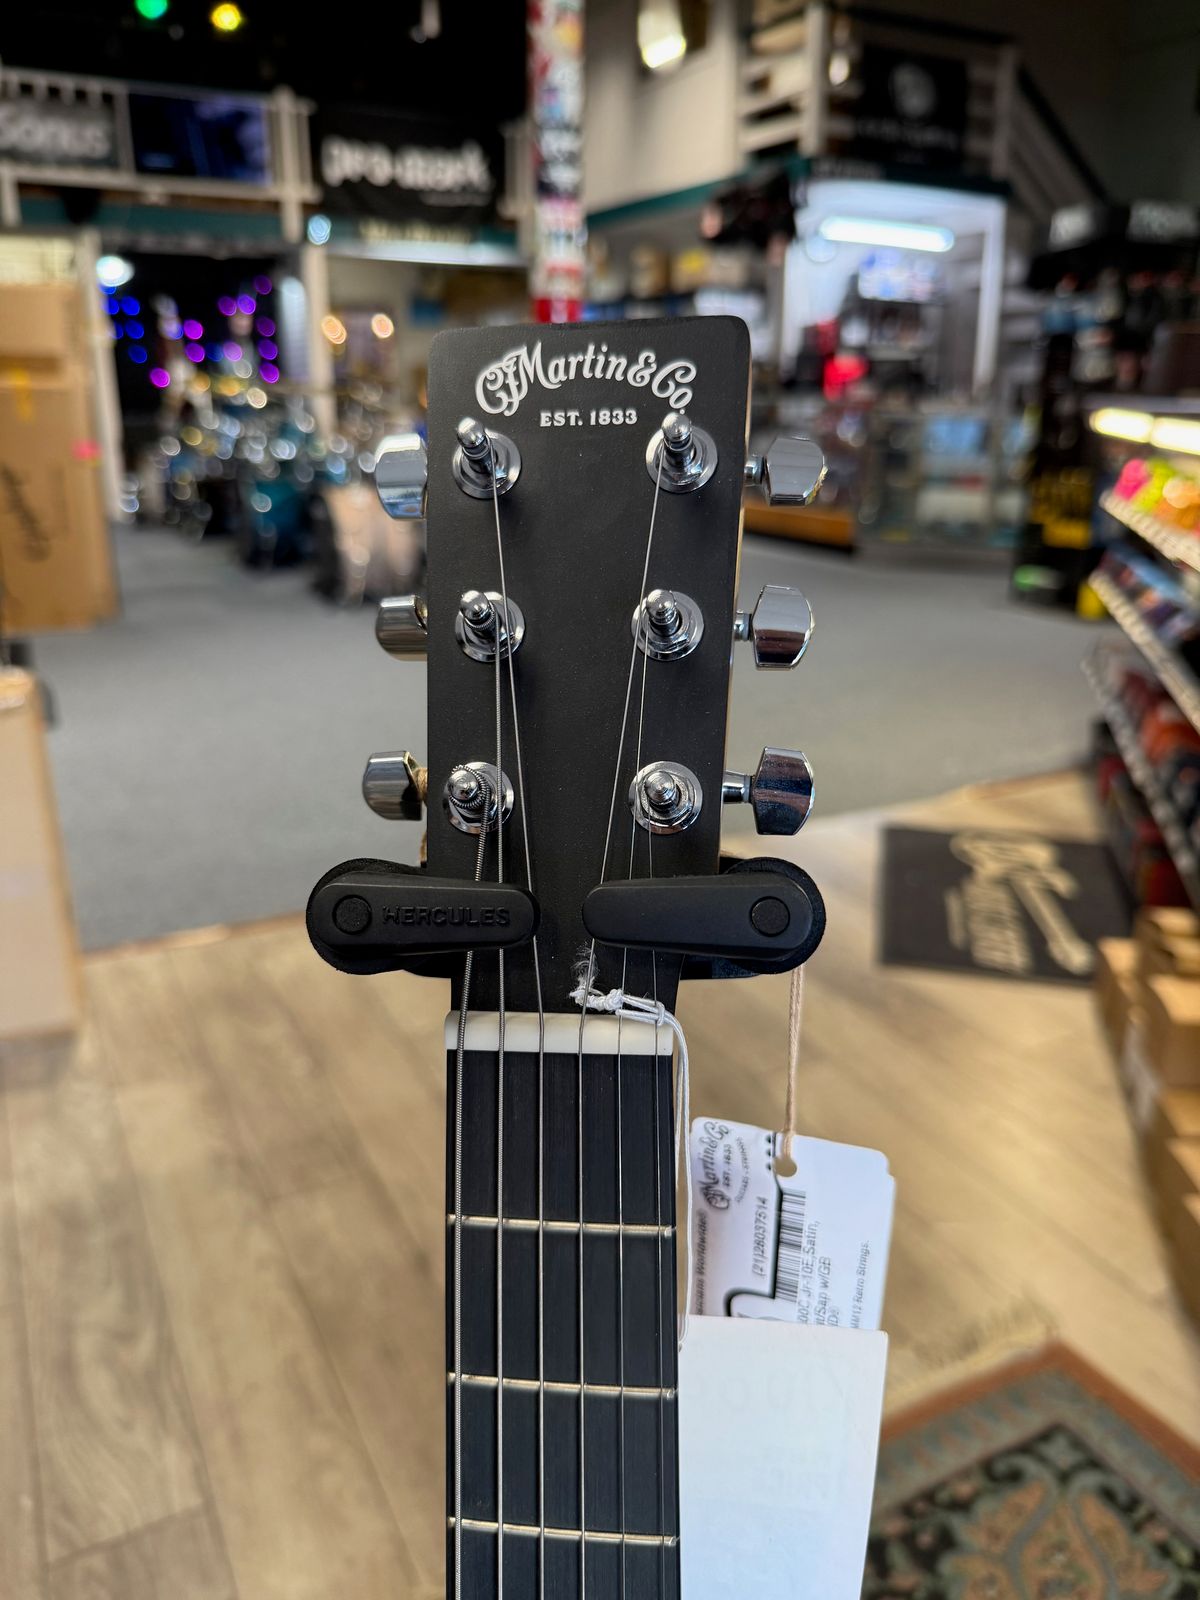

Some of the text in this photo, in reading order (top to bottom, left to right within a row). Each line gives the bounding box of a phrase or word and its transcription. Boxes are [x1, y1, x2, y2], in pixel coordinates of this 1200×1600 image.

[539, 408, 638, 427] EST. 1833
[383, 905, 511, 926] HERCULES
